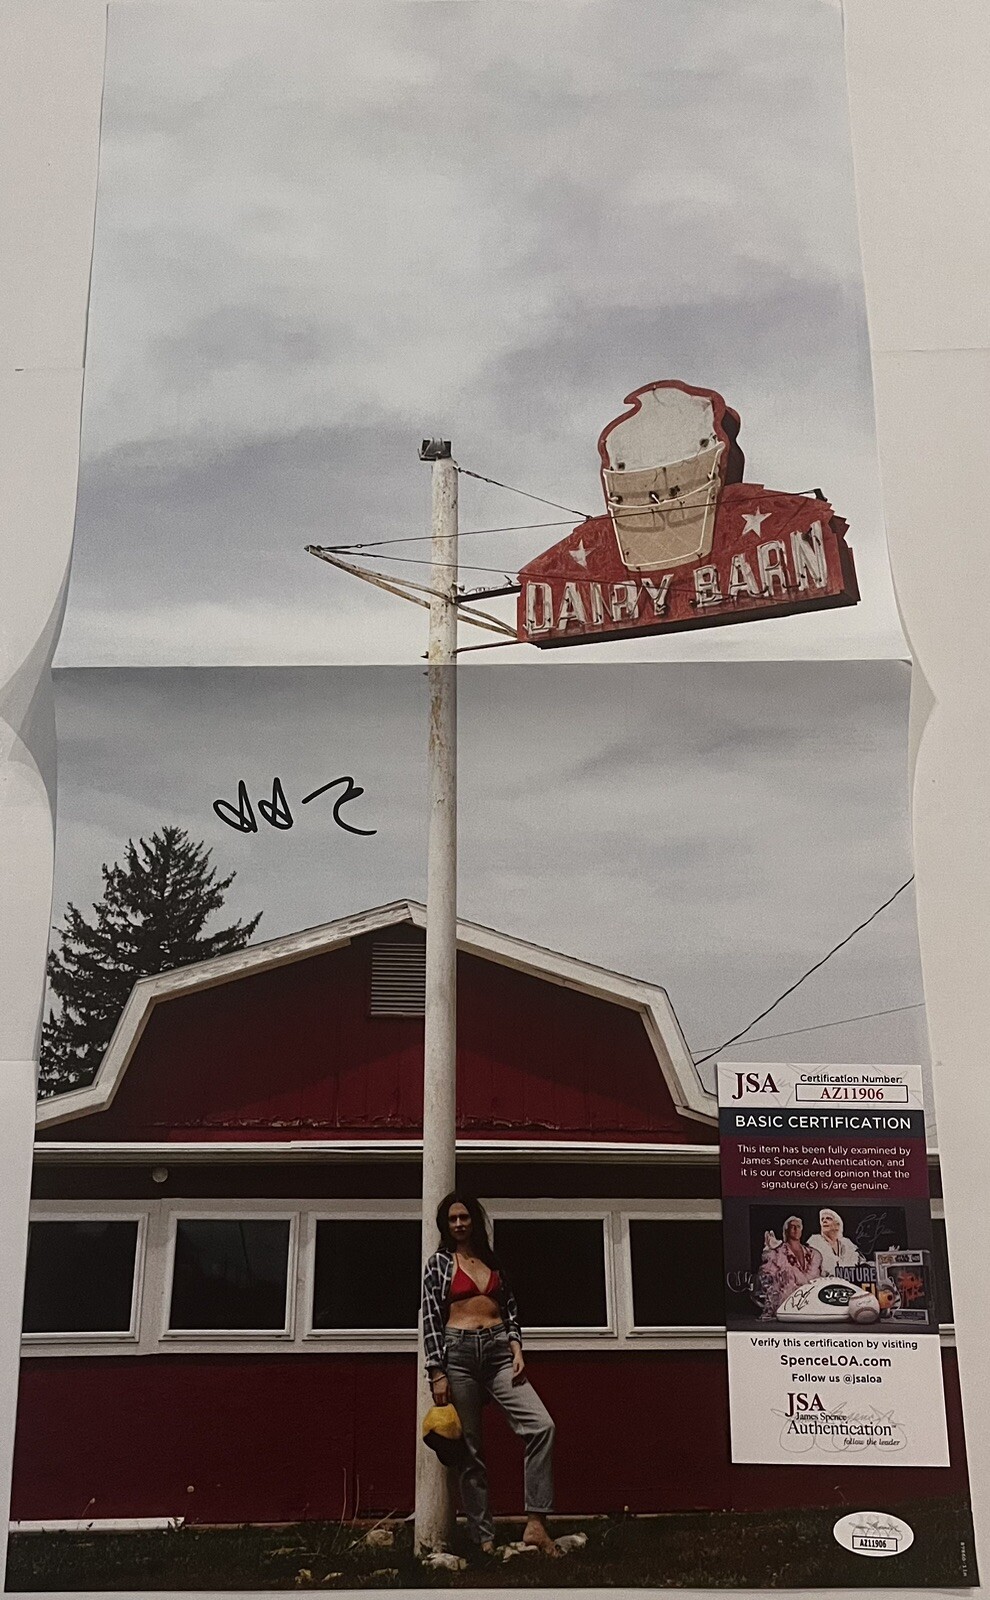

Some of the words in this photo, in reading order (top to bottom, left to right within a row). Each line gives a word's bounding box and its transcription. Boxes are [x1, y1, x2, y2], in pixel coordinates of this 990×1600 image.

[524, 574, 674, 635] DAIRY
[693, 520, 828, 607] BARN
[800, 1074, 859, 1082] Certification
[862, 1075, 903, 1083] Number:
[732, 1073, 780, 1099] JSA
[820, 1087, 884, 1100] AZ11906
[736, 1115, 783, 1128] BASIC
[788, 1116, 911, 1129] CERTIFICATION
[738, 1144, 756, 1153] This
[759, 1145, 780, 1153] item
[783, 1145, 799, 1153] has
[801, 1145, 826, 1154] been
[828, 1145, 848, 1156] fully
[850, 1146, 897, 1155] examined
[899, 1147, 911, 1156] by
[741, 1156, 771, 1165] James
[773, 1156, 809, 1166] Spence
[811, 1157, 884, 1167] Authentication,
[886, 1158, 905, 1167] and
[740, 1168, 747, 1176] it
[750, 1168, 758, 1176] is
[759, 1169, 776, 1177] our
[779, 1169, 832, 1178] considered
[834, 1170, 870, 1179] opinion
[872, 1170, 892, 1178] that
[894, 1170, 910, 1178] the
[761, 1181, 818, 1190] signature(s)
[821, 1181, 848, 1190] is/are
[850, 1182, 891, 1191] genuine.
[835, 1266, 876, 1282] NATURE
[750, 1338, 780, 1348] Verify
[783, 1338, 801, 1347] this
[804, 1339, 864, 1348] certification
[866, 1340, 879, 1350] by
[882, 1340, 918, 1350] visiting
[780, 1354, 891, 1367] SpenceLOA.com
[791, 1373, 826, 1382] Follow
[828, 1375, 840, 1383] us
[843, 1374, 882, 1384] @jsaloa
[785, 1393, 826, 1417] JSA
[796, 1411, 819, 1420] James
[820, 1411, 847, 1422] Spence
[844, 1437, 864, 1445] follow
[859, 1538, 887, 1548] AZ11906
